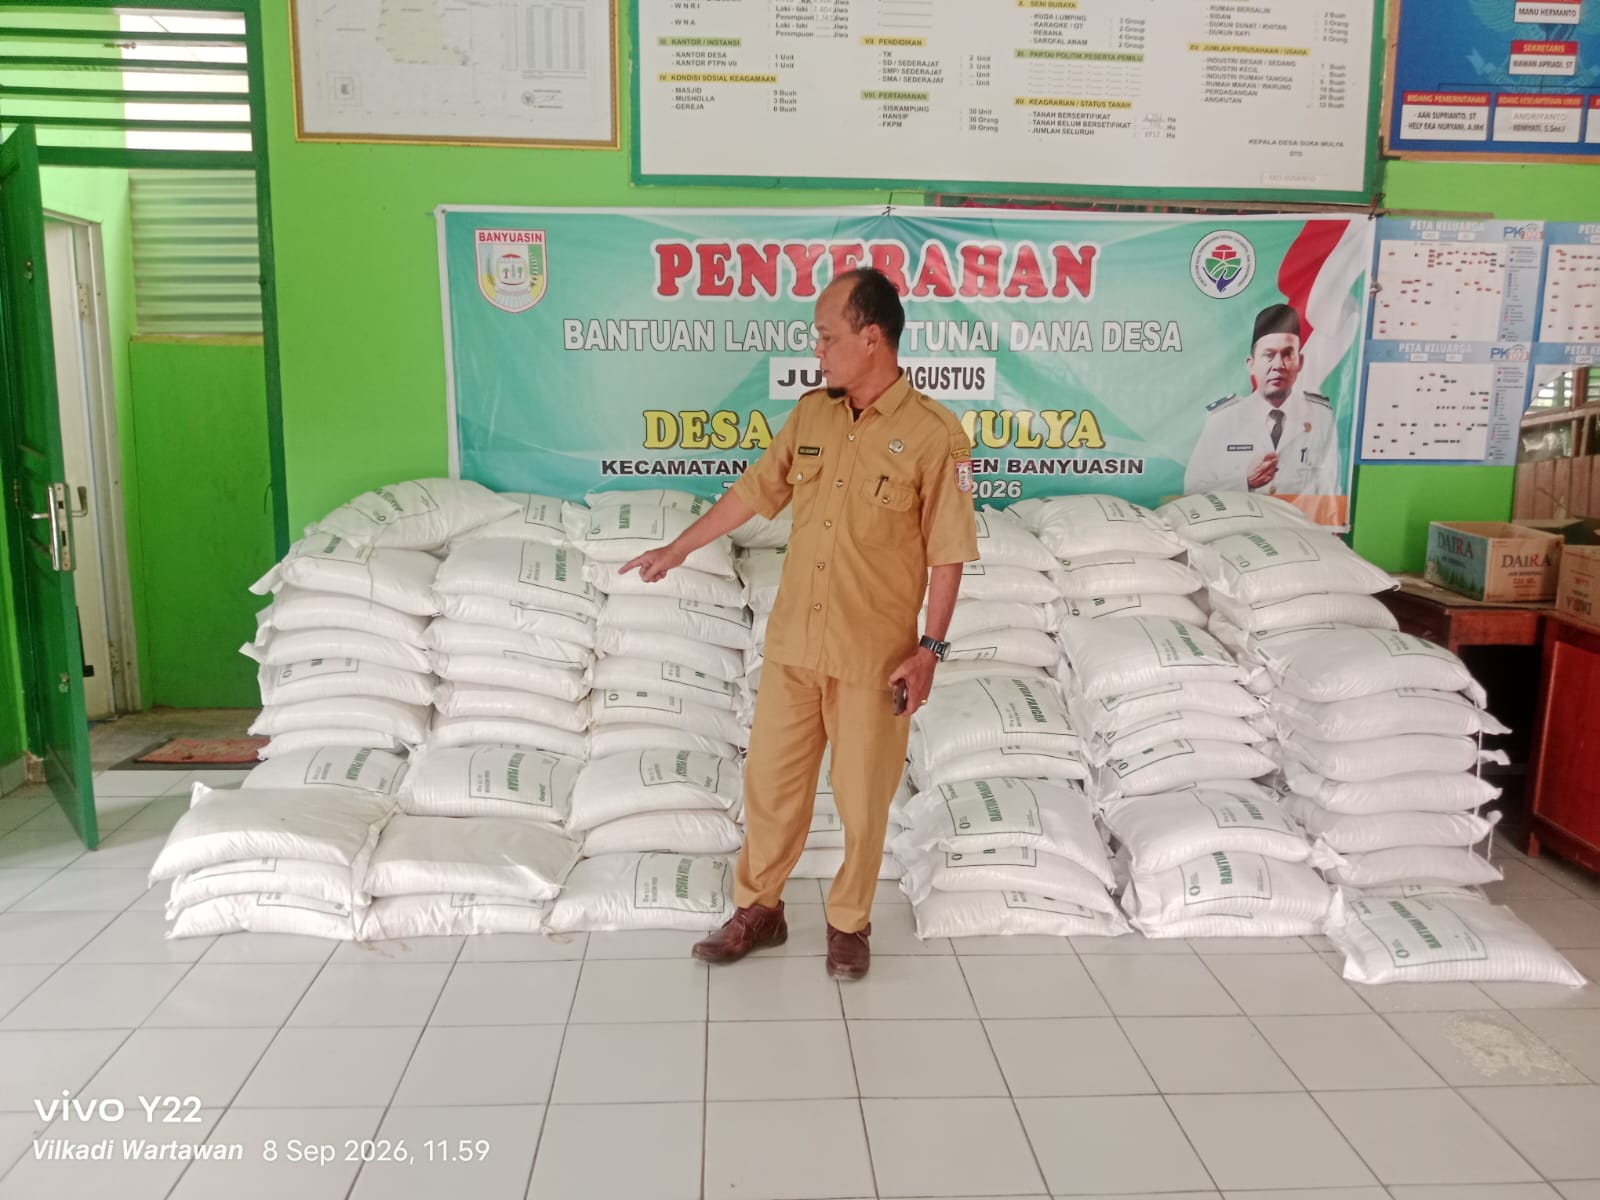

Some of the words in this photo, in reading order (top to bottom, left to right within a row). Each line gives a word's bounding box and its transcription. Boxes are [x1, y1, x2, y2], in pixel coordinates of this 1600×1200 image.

[1519, 8, 1539, 16] MANU
[1541, 8, 1577, 17] HERMANTO
[878, 39, 922, 47] PENDIDIKAN
[1055, 52, 1083, 60] POLITIK
[1117, 54, 1143, 62] PEMILU
[898, 60, 939, 68] SEDERAJAT
[901, 68, 942, 76] SEDERAJAT
[729, 75, 776, 83] KEAGAMAAN
[903, 76, 944, 84] SEDERAJAT
[878, 92, 927, 100] PERTAHANAN
[1029, 99, 1075, 107] KEAGRARIAN
[978, 117, 999, 125] Orang
[1057, 112, 1111, 121] BERSERTIFIKAT
[1033, 119, 1056, 127] TANAH
[1057, 120, 1081, 128] BELUM
[1083, 121, 1131, 129] BERSETIFIKAT
[978, 125, 999, 133] Orang
[1062, 129, 1095, 137] SELURUH
[478, 231, 543, 243] BANYUASIN
[563, 319, 715, 352] BANTUAN
[904, 320, 999, 352] TUNAI
[1009, 320, 1093, 352] DANA
[1102, 320, 1183, 352] DESA
[643, 410, 774, 450] DESA
[602, 460, 748, 476] KECAMATAN
[1007, 459, 1144, 475] BANYUASIN
[971, 480, 1022, 498] 2026
[1437, 531, 1474, 560] DAIRA
[1501, 554, 1552, 569] DAIRA
[506, 767, 519, 792] PANGAN
[675, 875, 689, 899] PANGAN
[1407, 918, 1442, 950] BANTUAN
